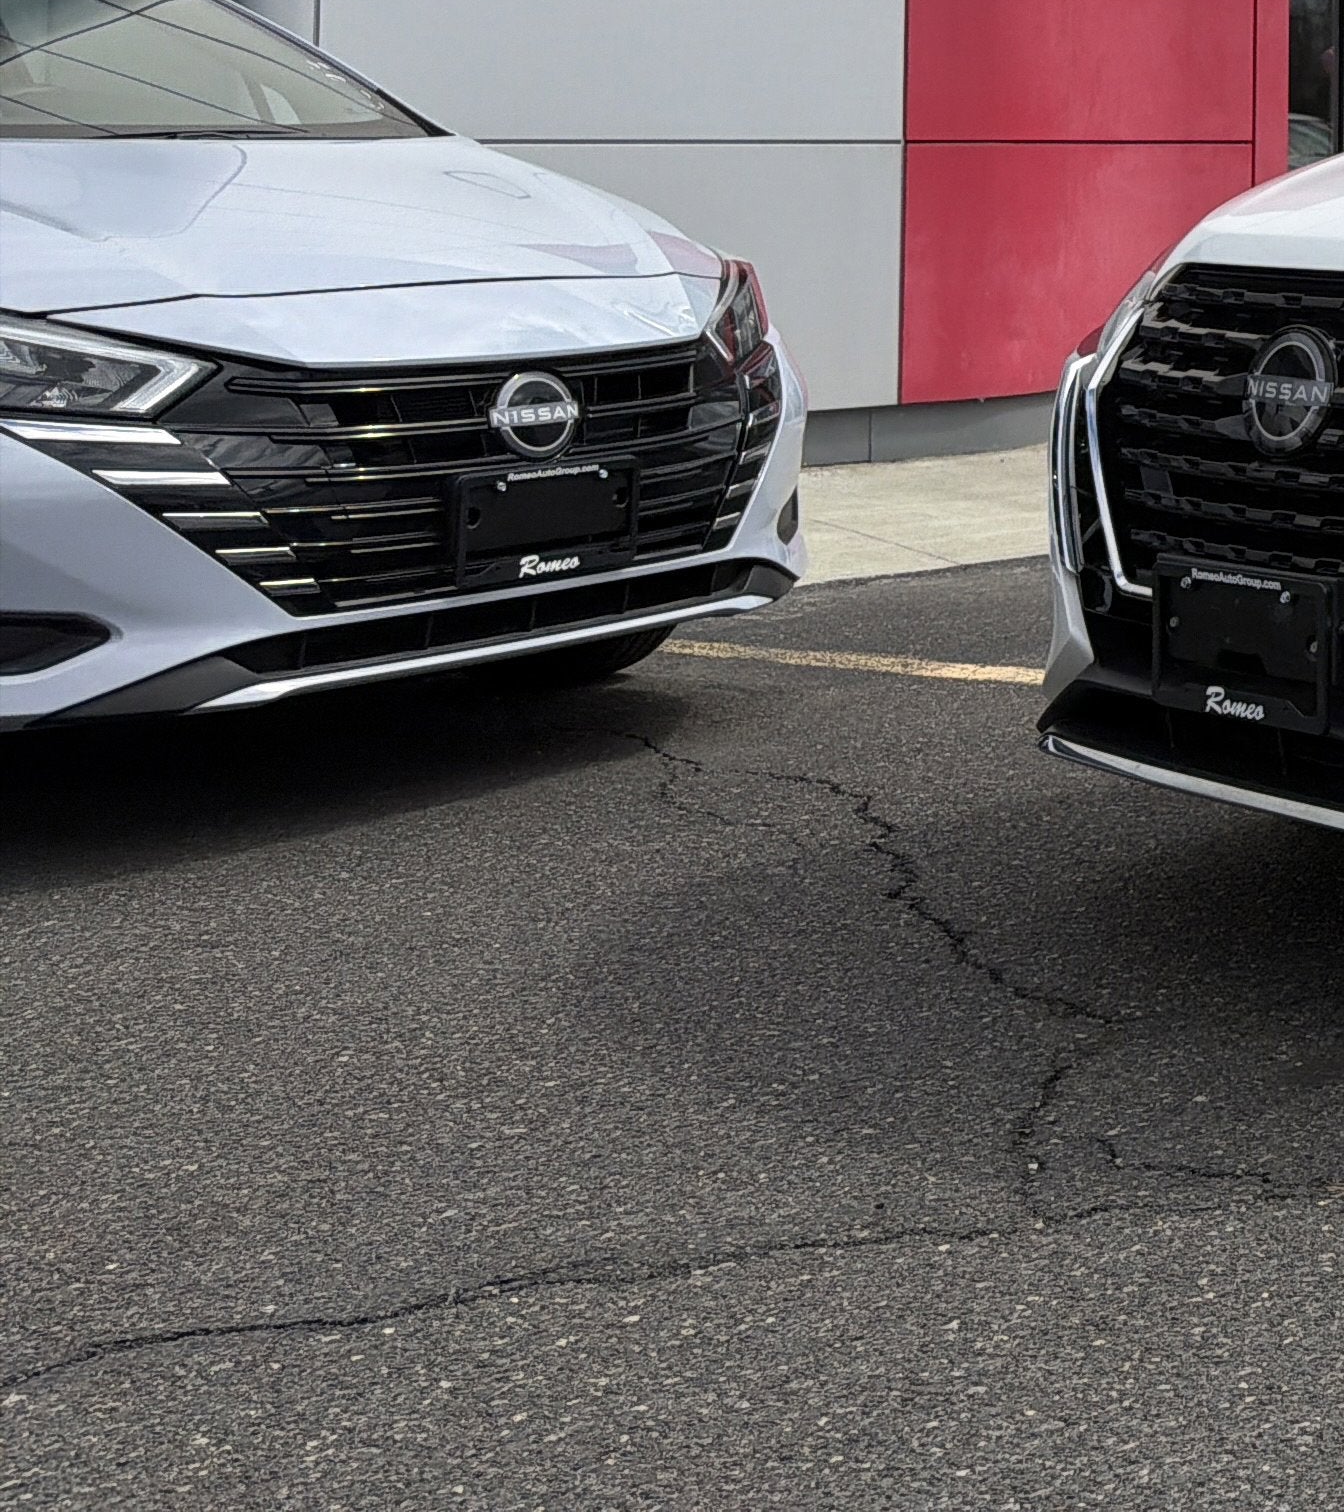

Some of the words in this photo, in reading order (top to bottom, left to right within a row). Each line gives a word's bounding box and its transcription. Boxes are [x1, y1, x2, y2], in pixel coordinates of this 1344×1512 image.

[1247, 376, 1328, 403] NISSAN
[491, 402, 579, 427] NISSAN
[507, 464, 600, 483] RomeoAutoGroup.com
[518, 554, 580, 579] Romeo
[1191, 567, 1282, 591] RomeoAutoGroup.com
[1205, 685, 1265, 721] Romeo
